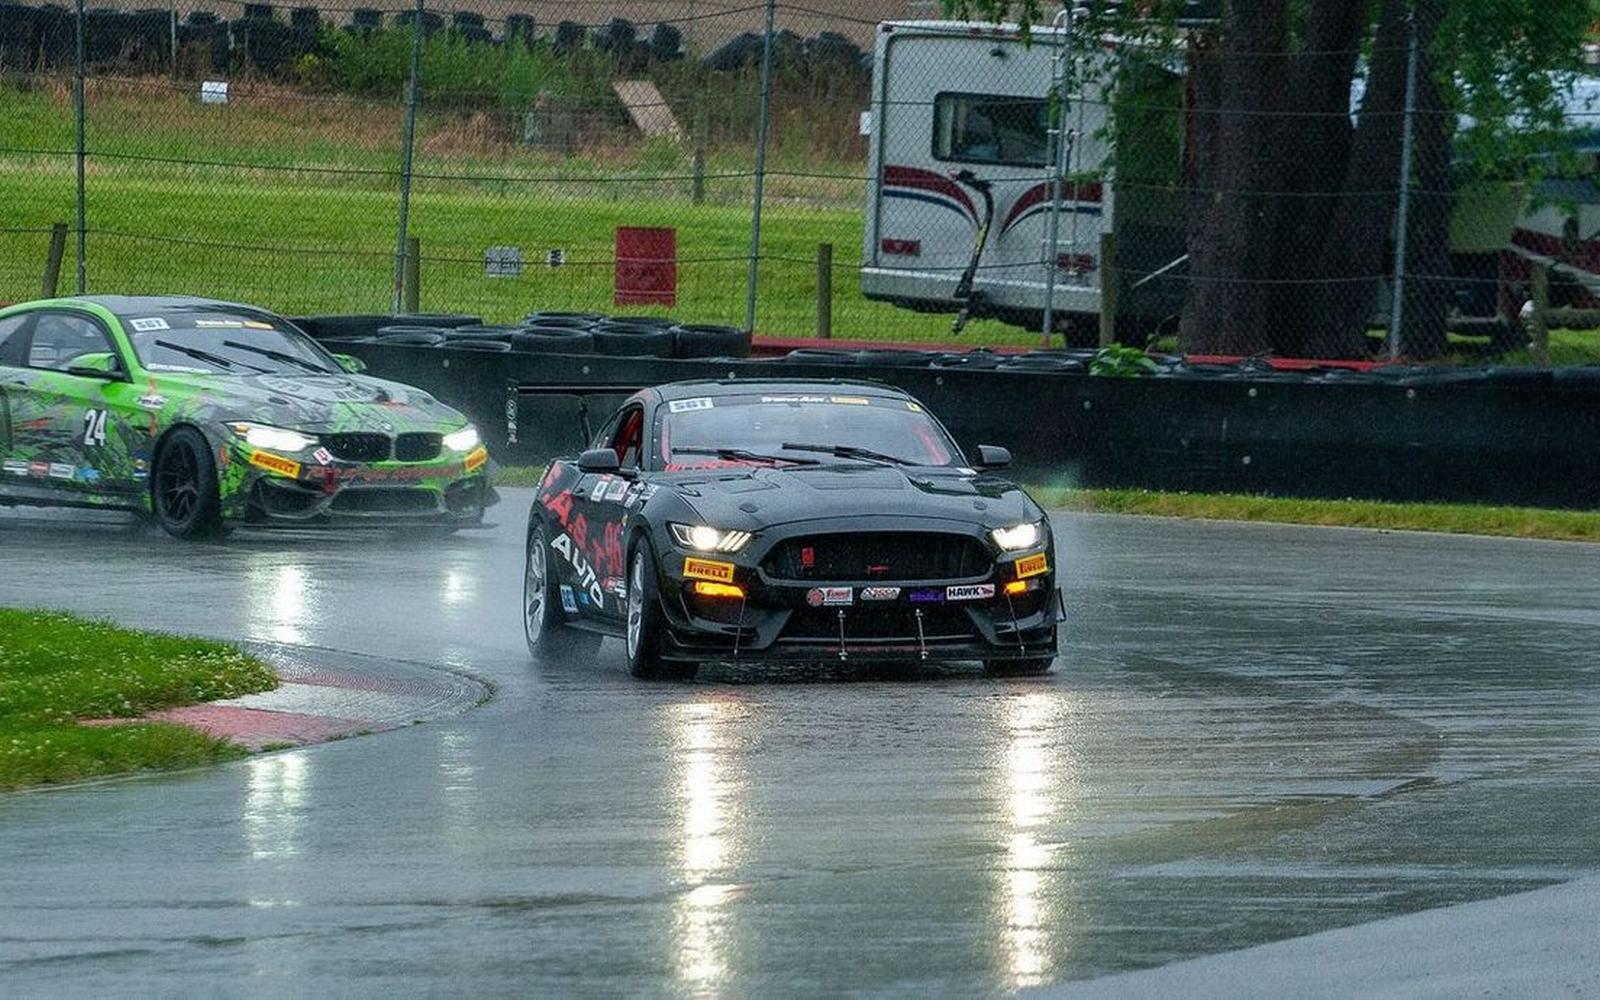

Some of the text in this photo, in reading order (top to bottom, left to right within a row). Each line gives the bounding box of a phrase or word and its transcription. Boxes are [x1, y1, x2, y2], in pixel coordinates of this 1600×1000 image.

[84, 409, 107, 446] 24
[551, 533, 604, 609] AUTO
[688, 560, 730, 578] PIRELLI
[948, 586, 980, 598] HAWK
